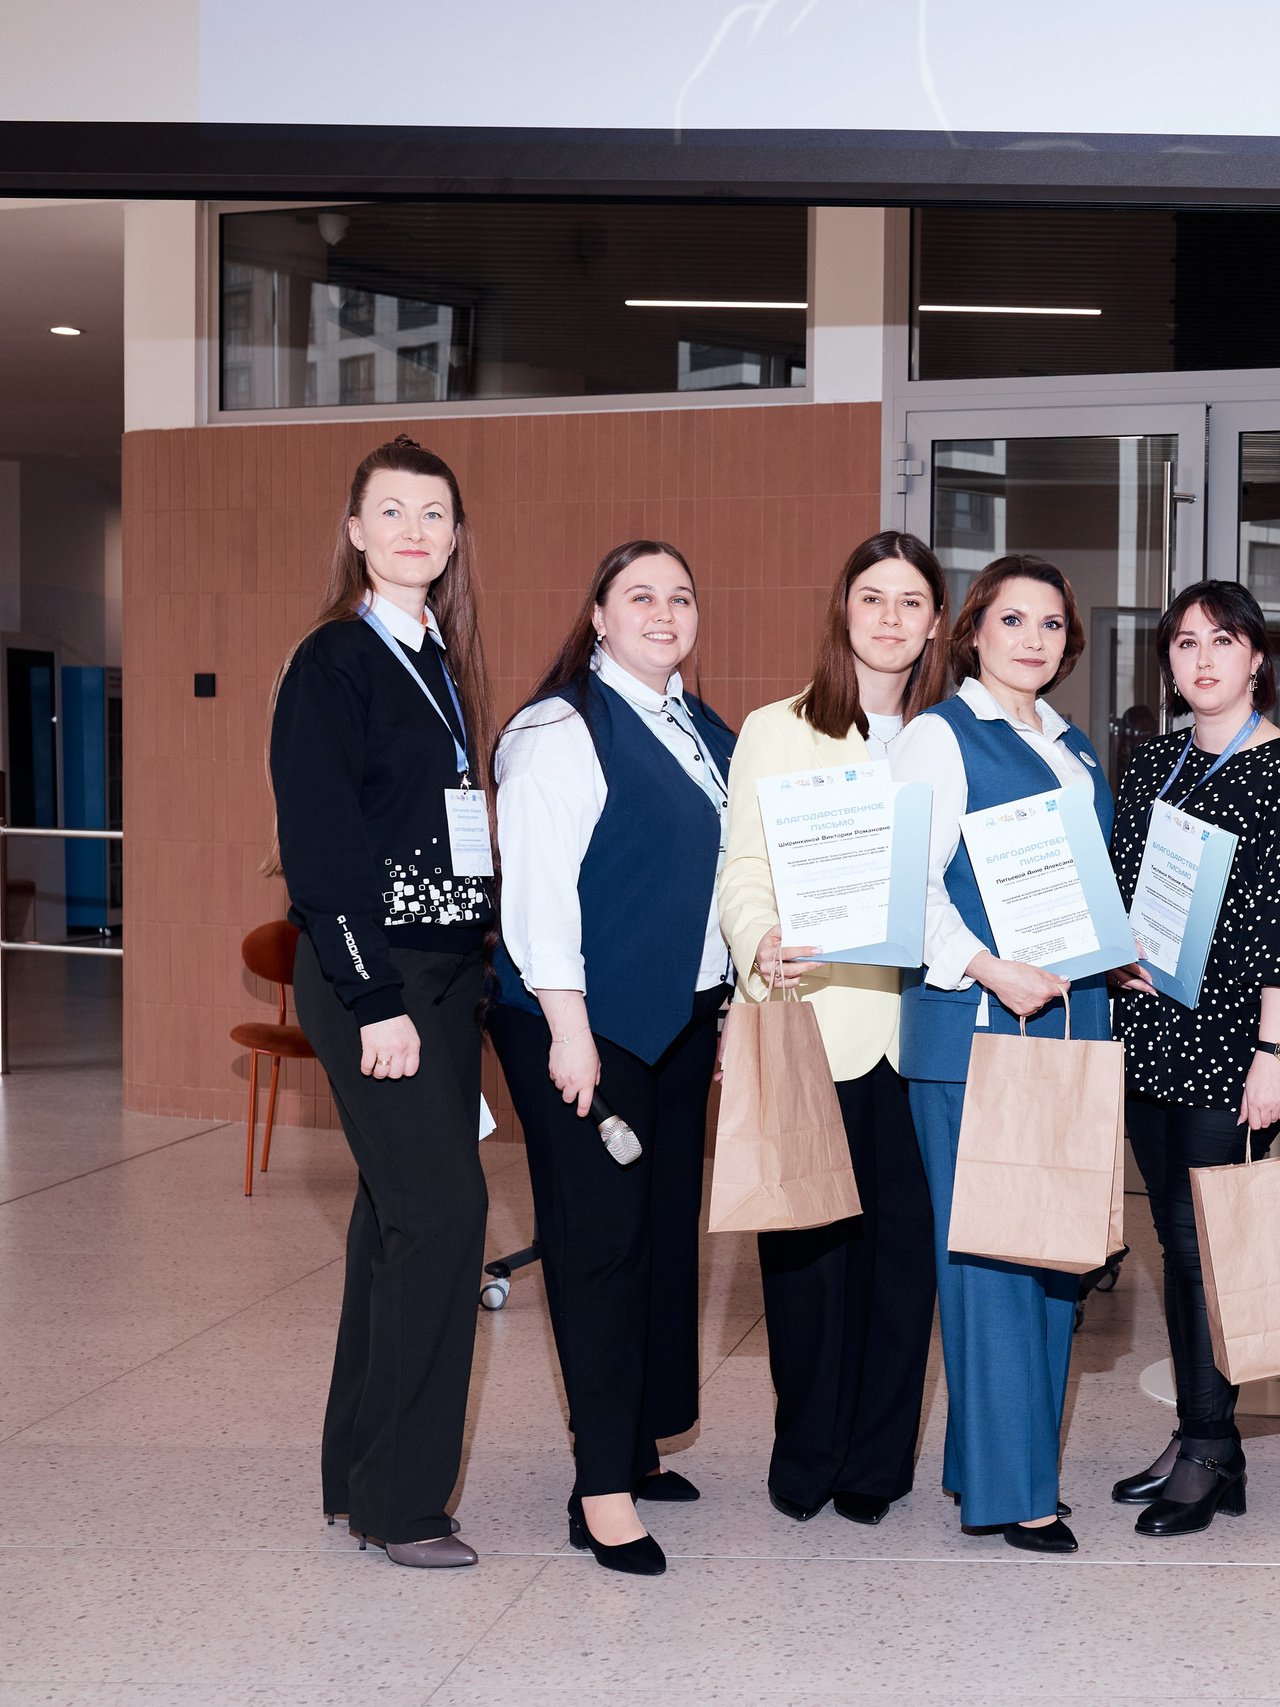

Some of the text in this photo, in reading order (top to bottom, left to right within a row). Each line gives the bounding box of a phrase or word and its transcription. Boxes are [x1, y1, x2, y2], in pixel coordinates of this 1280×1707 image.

[776, 802, 884, 826] БЛАГОДАРСТВЕННОЕ
[810, 818, 854, 832] ПИСЬМО
[822, 832, 852, 841] Виктории
[986, 835, 1068, 864] БЛАГОДАРСТВЕН
[1020, 849, 1061, 866] ПИСЬМО
[1027, 868, 1043, 876] Анне
[1044, 859, 1074, 870] Александ
[1167, 862, 1192, 880] ПИСЬМО
